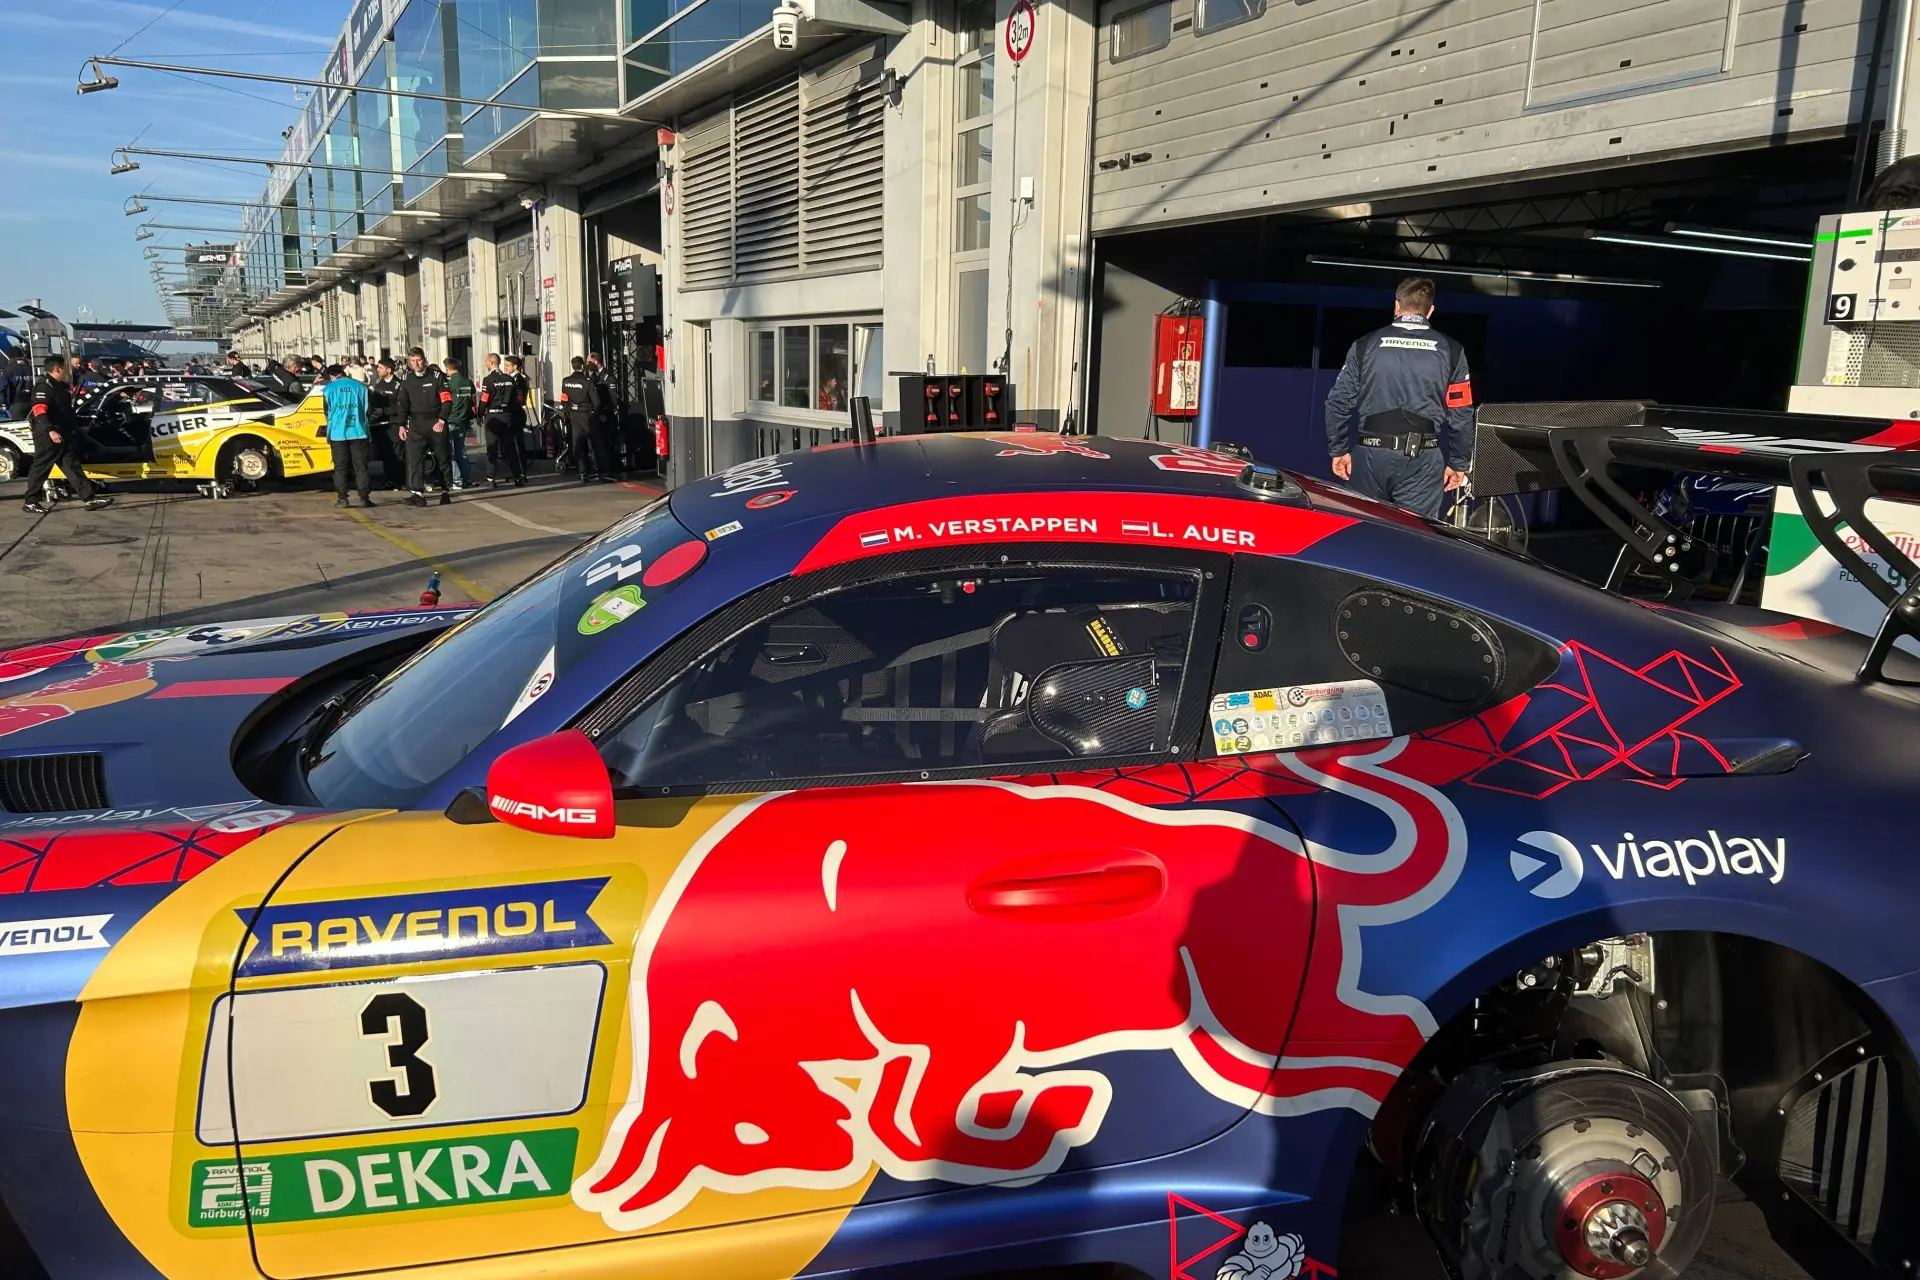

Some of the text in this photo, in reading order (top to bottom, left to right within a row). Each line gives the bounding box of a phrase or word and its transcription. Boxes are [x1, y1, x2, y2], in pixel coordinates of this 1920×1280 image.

[1835, 295, 1851, 318] 9
[1385, 339, 1434, 348] RAVENOL
[894, 518, 1098, 541] M. VERSTAPPEN
[1152, 521, 1256, 547] L. AUER
[1253, 690, 1273, 699] ADAC
[508, 801, 597, 823] AMG
[1590, 829, 1785, 886] viaplay
[271, 899, 577, 957] RAVENOL
[358, 991, 440, 1119] 3
[304, 1139, 551, 1213] DEKRA
